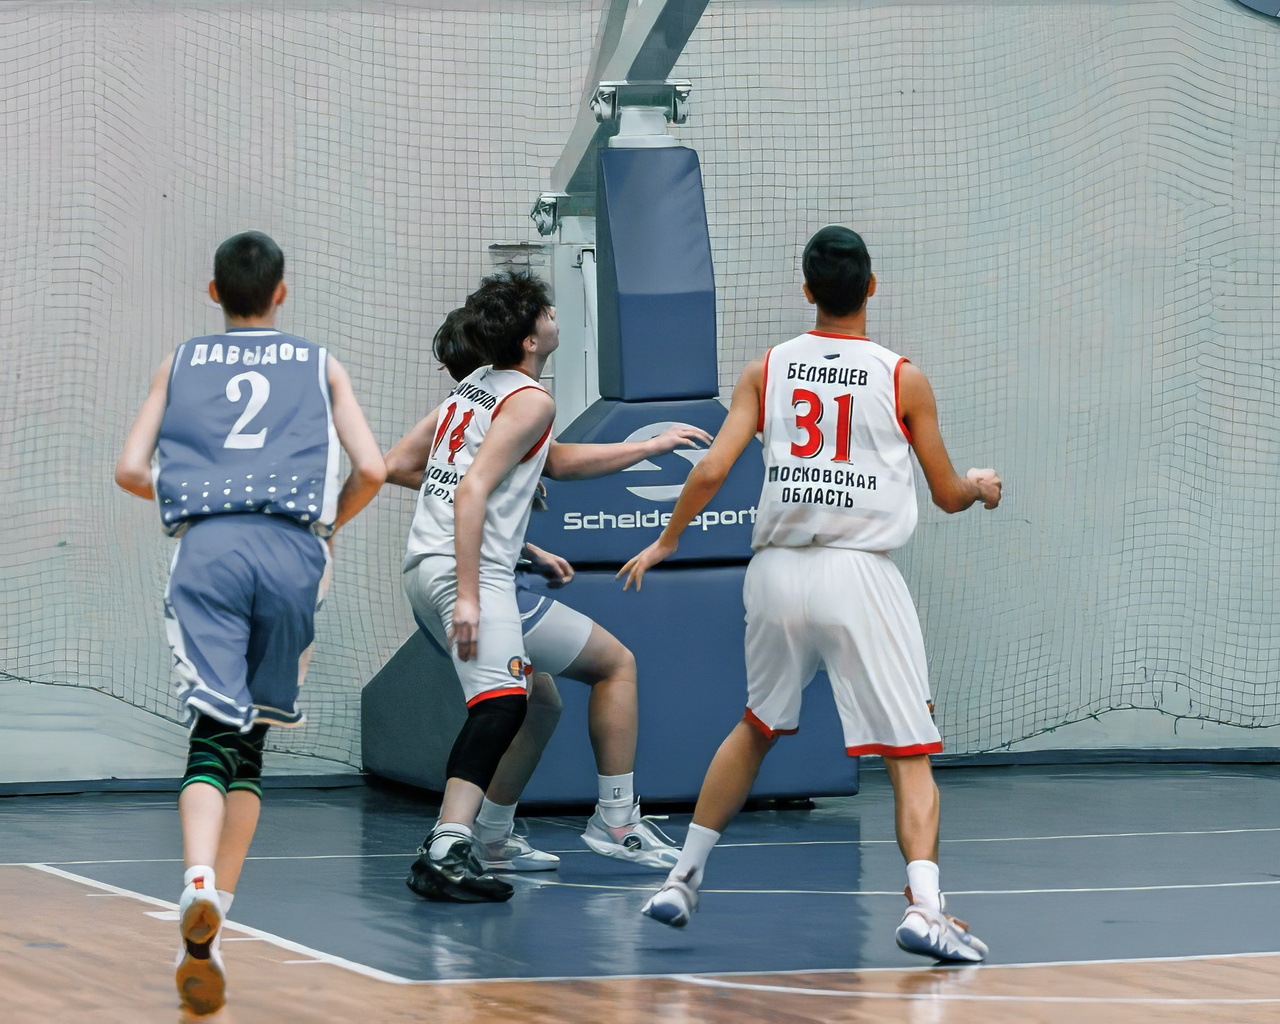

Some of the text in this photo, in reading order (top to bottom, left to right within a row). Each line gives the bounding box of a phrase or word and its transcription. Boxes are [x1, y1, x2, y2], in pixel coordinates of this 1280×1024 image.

[787, 362, 869, 387] БЕЛЯВЦЕВ
[223, 370, 271, 450] 2
[790, 388, 854, 466] 31
[781, 487, 854, 509] ОБЛАСТЬ
